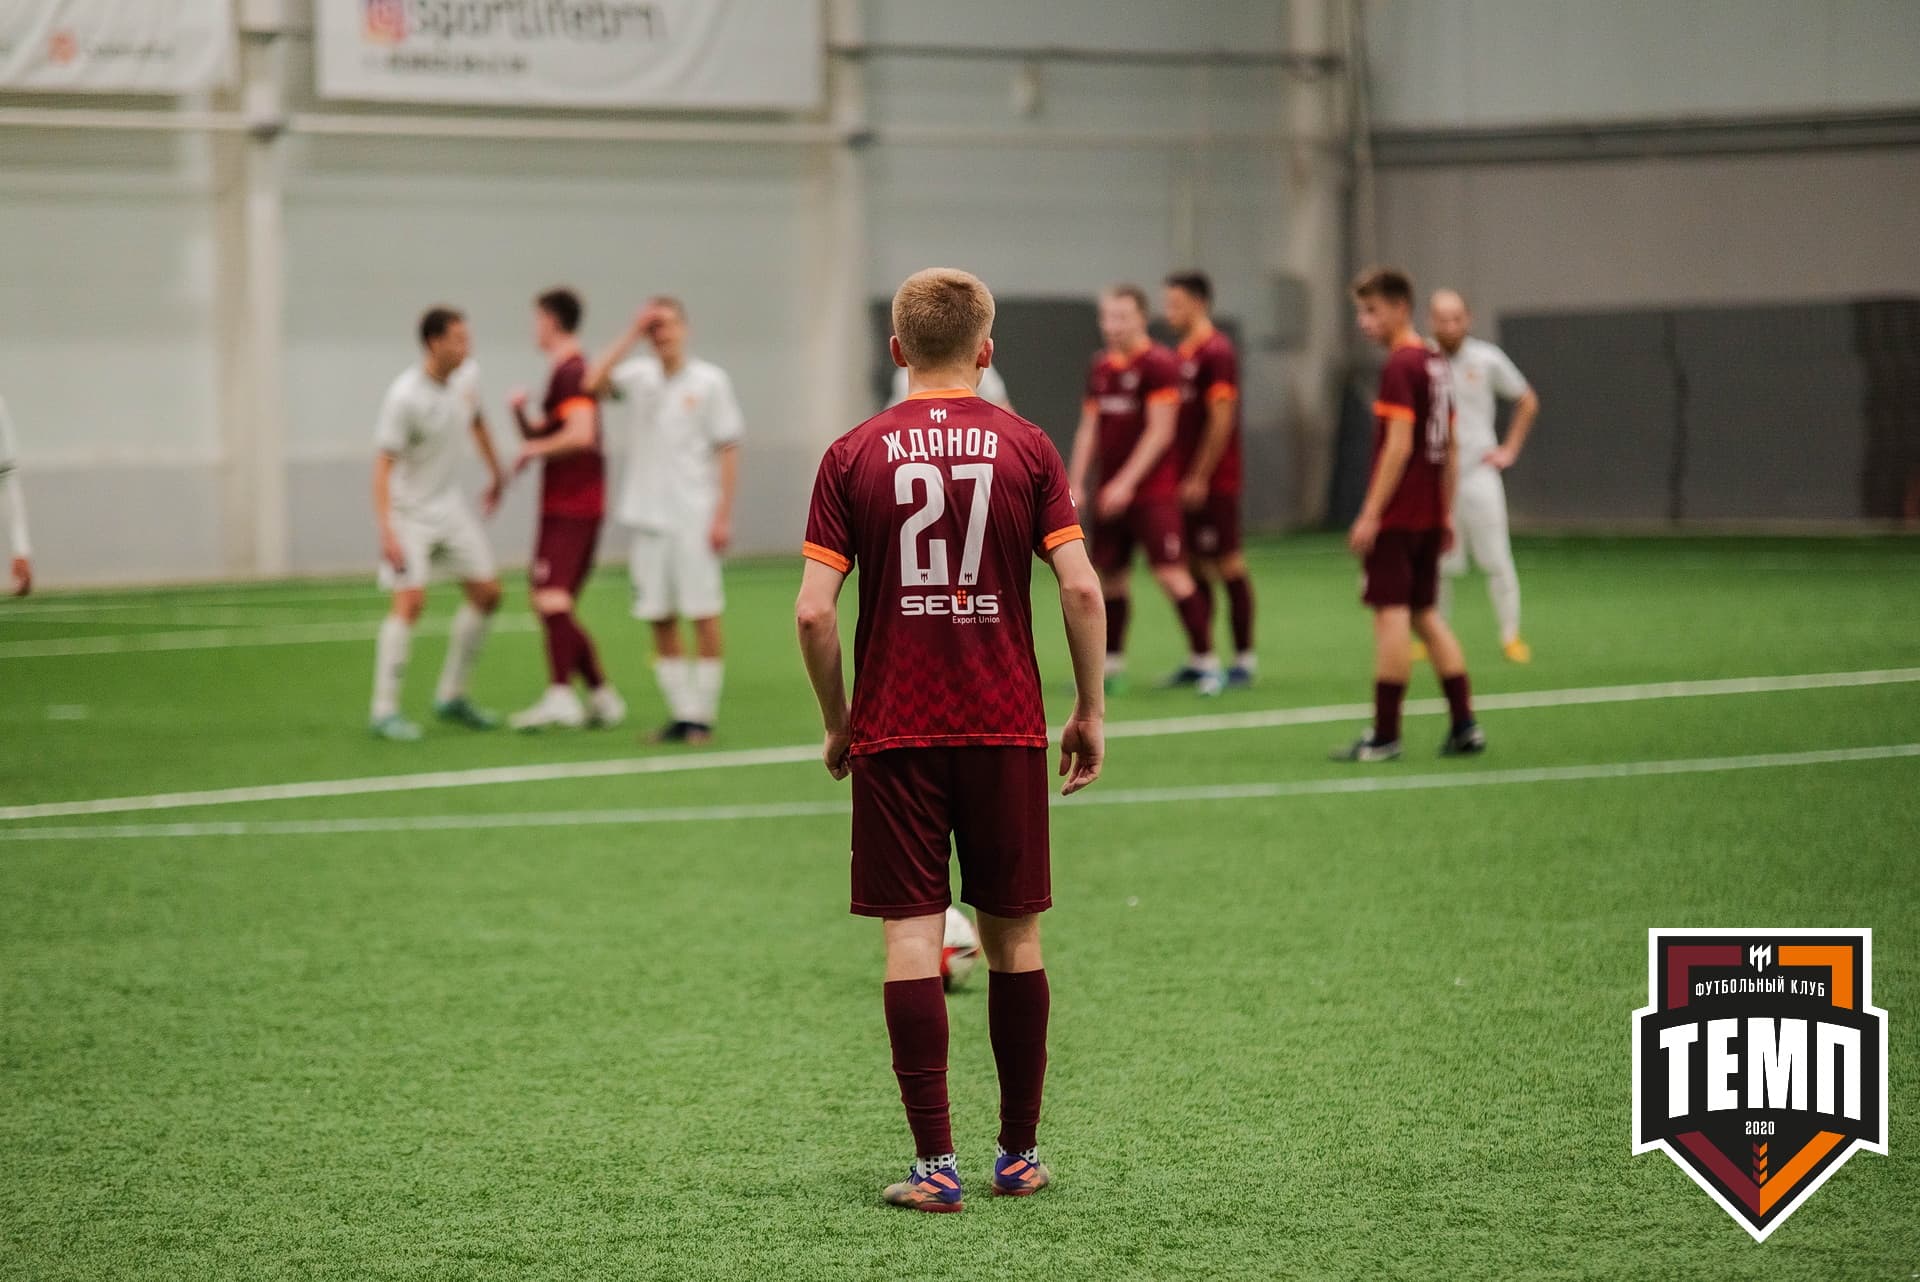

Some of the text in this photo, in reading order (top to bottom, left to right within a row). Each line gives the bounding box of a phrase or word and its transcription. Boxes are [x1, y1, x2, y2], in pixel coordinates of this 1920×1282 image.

[882, 428, 998, 462] ЖДАНОВ
[895, 463, 993, 586] 27
[952, 615, 1000, 625] Export Union
